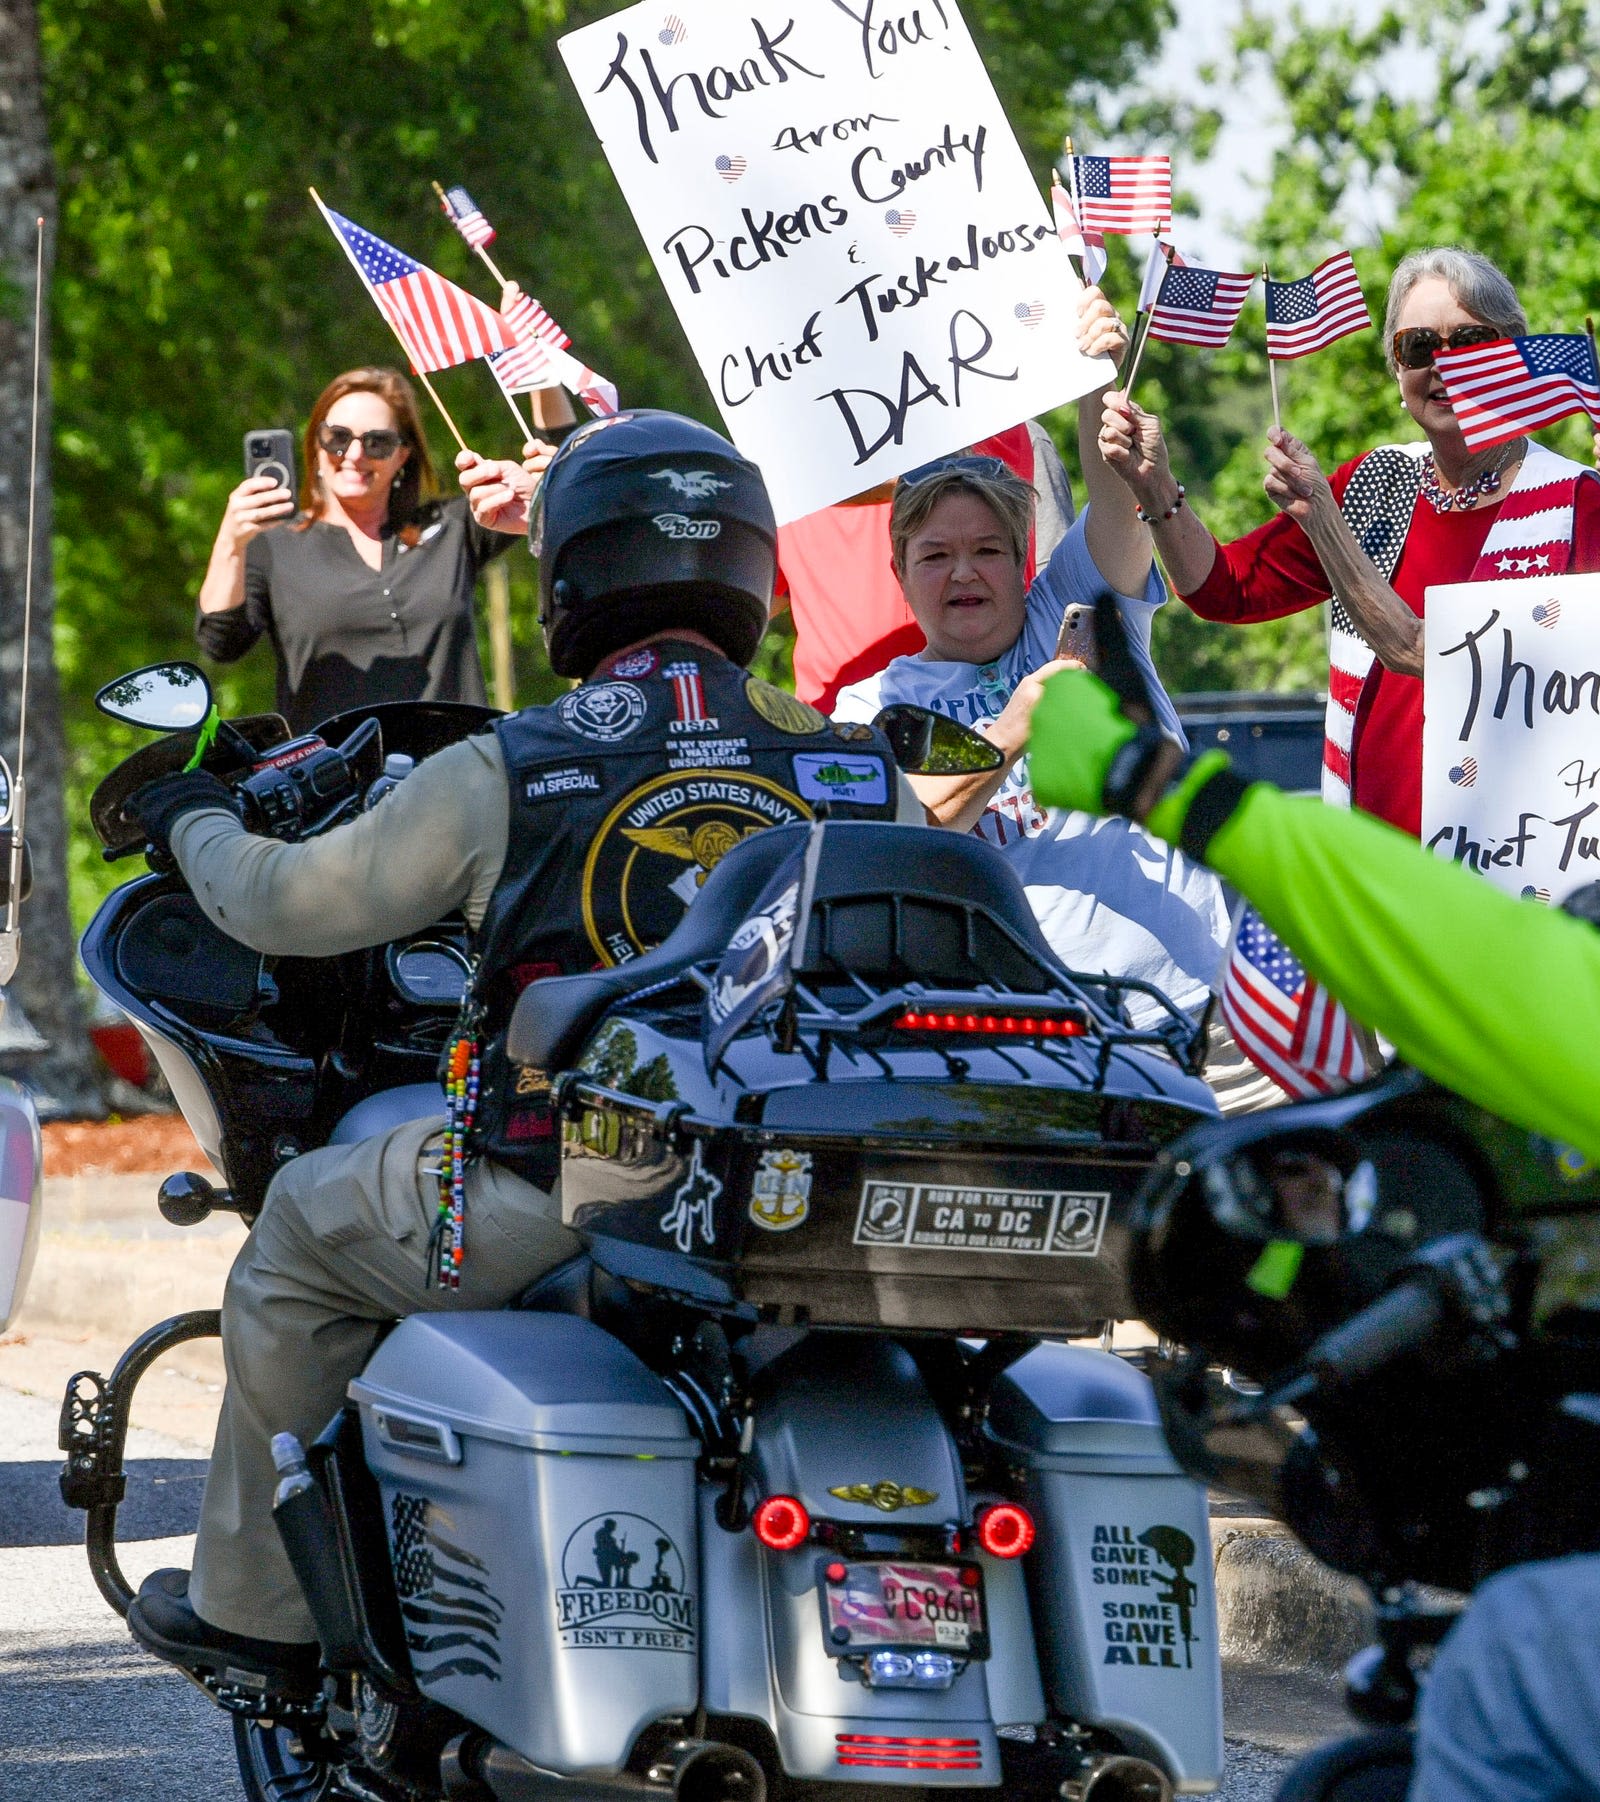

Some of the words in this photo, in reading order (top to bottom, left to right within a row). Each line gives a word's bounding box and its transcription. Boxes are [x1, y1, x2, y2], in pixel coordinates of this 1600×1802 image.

[595, 18, 825, 163] Thank
[831, 0, 952, 78] You!
[773, 113, 900, 153] from
[663, 195, 848, 293] Pickens
[852, 125, 986, 203] County
[721, 311, 825, 406] Chief
[835, 224, 1057, 341] Tuskaloosa
[814, 309, 1018, 466] DAR
[671, 719, 718, 733] USA
[666, 740, 678, 750] IN
[679, 740, 696, 750] MY
[698, 738, 748, 748] DEFENSE
[685, 748, 709, 757] WAS
[711, 747, 738, 757] LEFT
[669, 755, 751, 769] UNSUPERVISED
[526, 781, 545, 797] I'M
[547, 774, 600, 794] SPECIAL
[627, 786, 686, 829] UNITED
[688, 782, 750, 804] STATES
[753, 791, 799, 826] NAVY
[928, 1190, 954, 1203] RUN
[957, 1191, 981, 1204] FOR
[986, 1193, 1009, 1206] THE
[1011, 1195, 1043, 1208] WALL
[934, 1206, 964, 1230] CA
[973, 1213, 992, 1228] TO
[998, 1211, 1032, 1233] DC
[1094, 1525, 1135, 1545] ALL
[1091, 1546, 1150, 1565] GAVE
[1093, 1567, 1150, 1586] SOME
[560, 1591, 696, 1627] FREEDOM
[1102, 1601, 1173, 1621] SOME
[574, 1630, 626, 1645] ISN'T
[632, 1631, 686, 1648] FREE
[1105, 1621, 1176, 1645] GAVE
[1104, 1645, 1181, 1669] ALL
